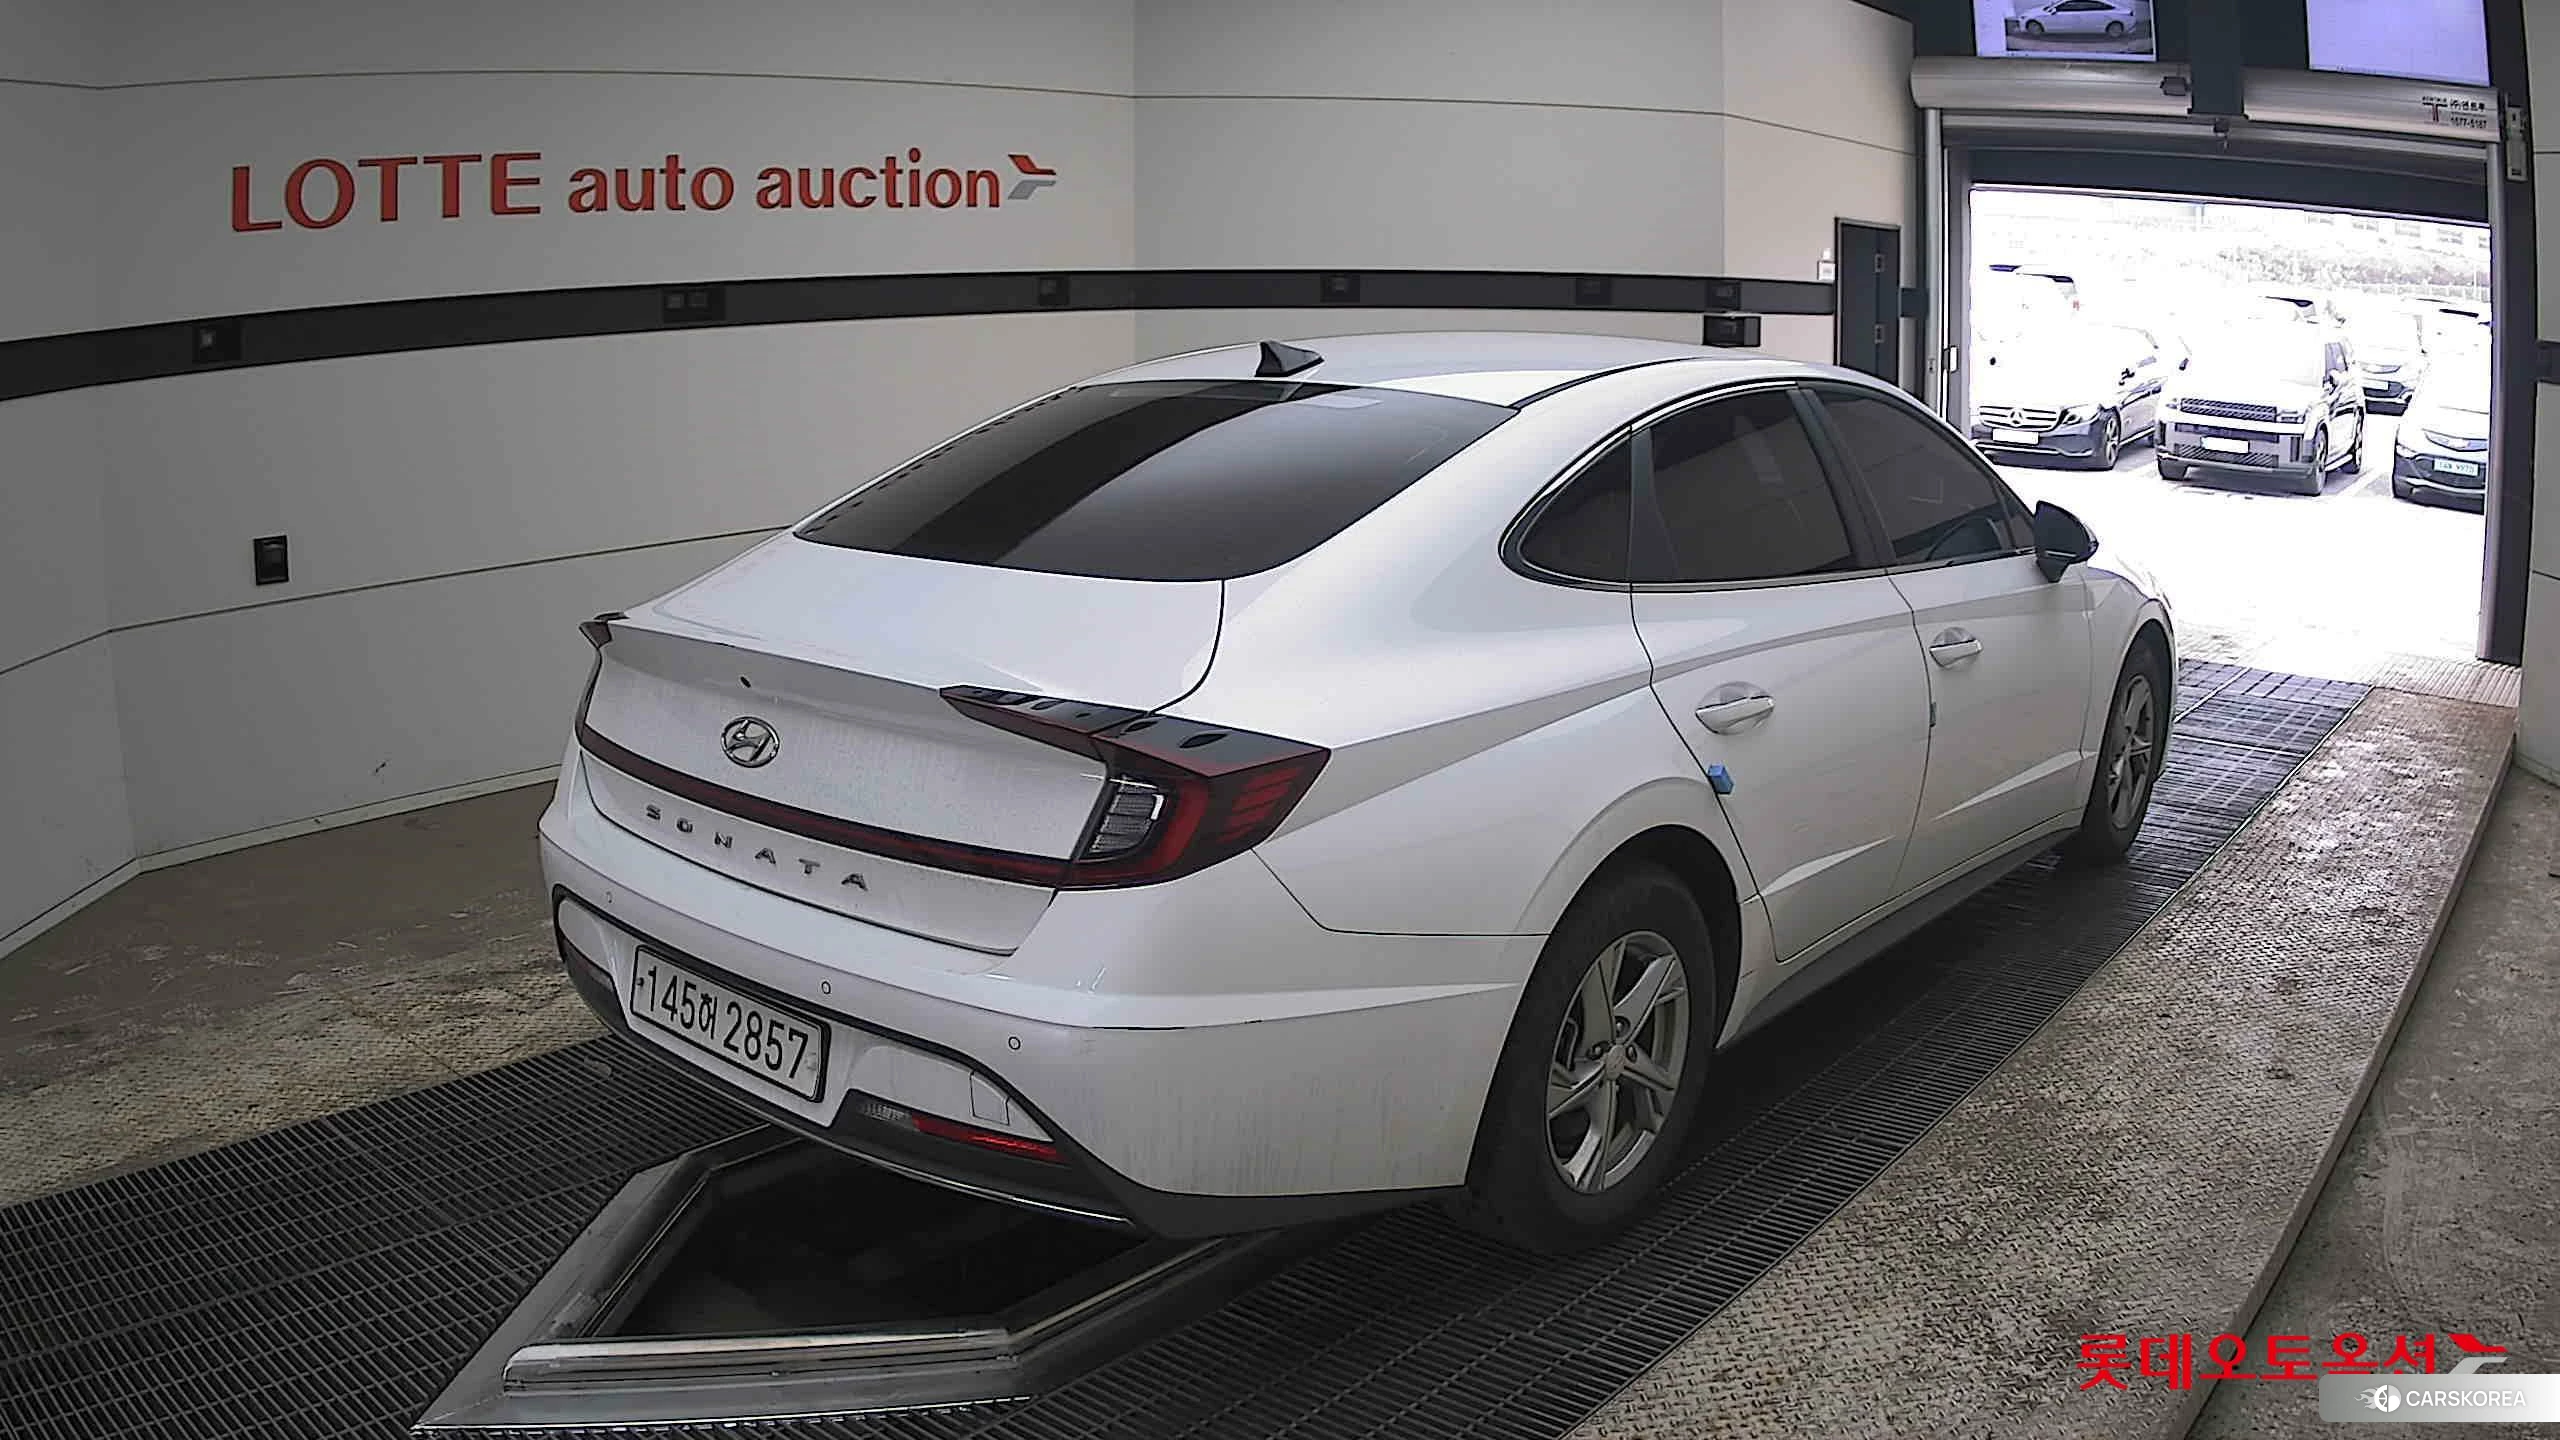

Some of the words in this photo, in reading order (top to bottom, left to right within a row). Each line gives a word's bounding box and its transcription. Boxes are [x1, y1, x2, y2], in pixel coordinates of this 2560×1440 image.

[231, 152, 541, 232] LOTTE
[567, 153, 735, 213] auto
[756, 147, 1001, 209] auction
[645, 804, 868, 892] SONATA
[723, 1001, 809, 1079] 2857
